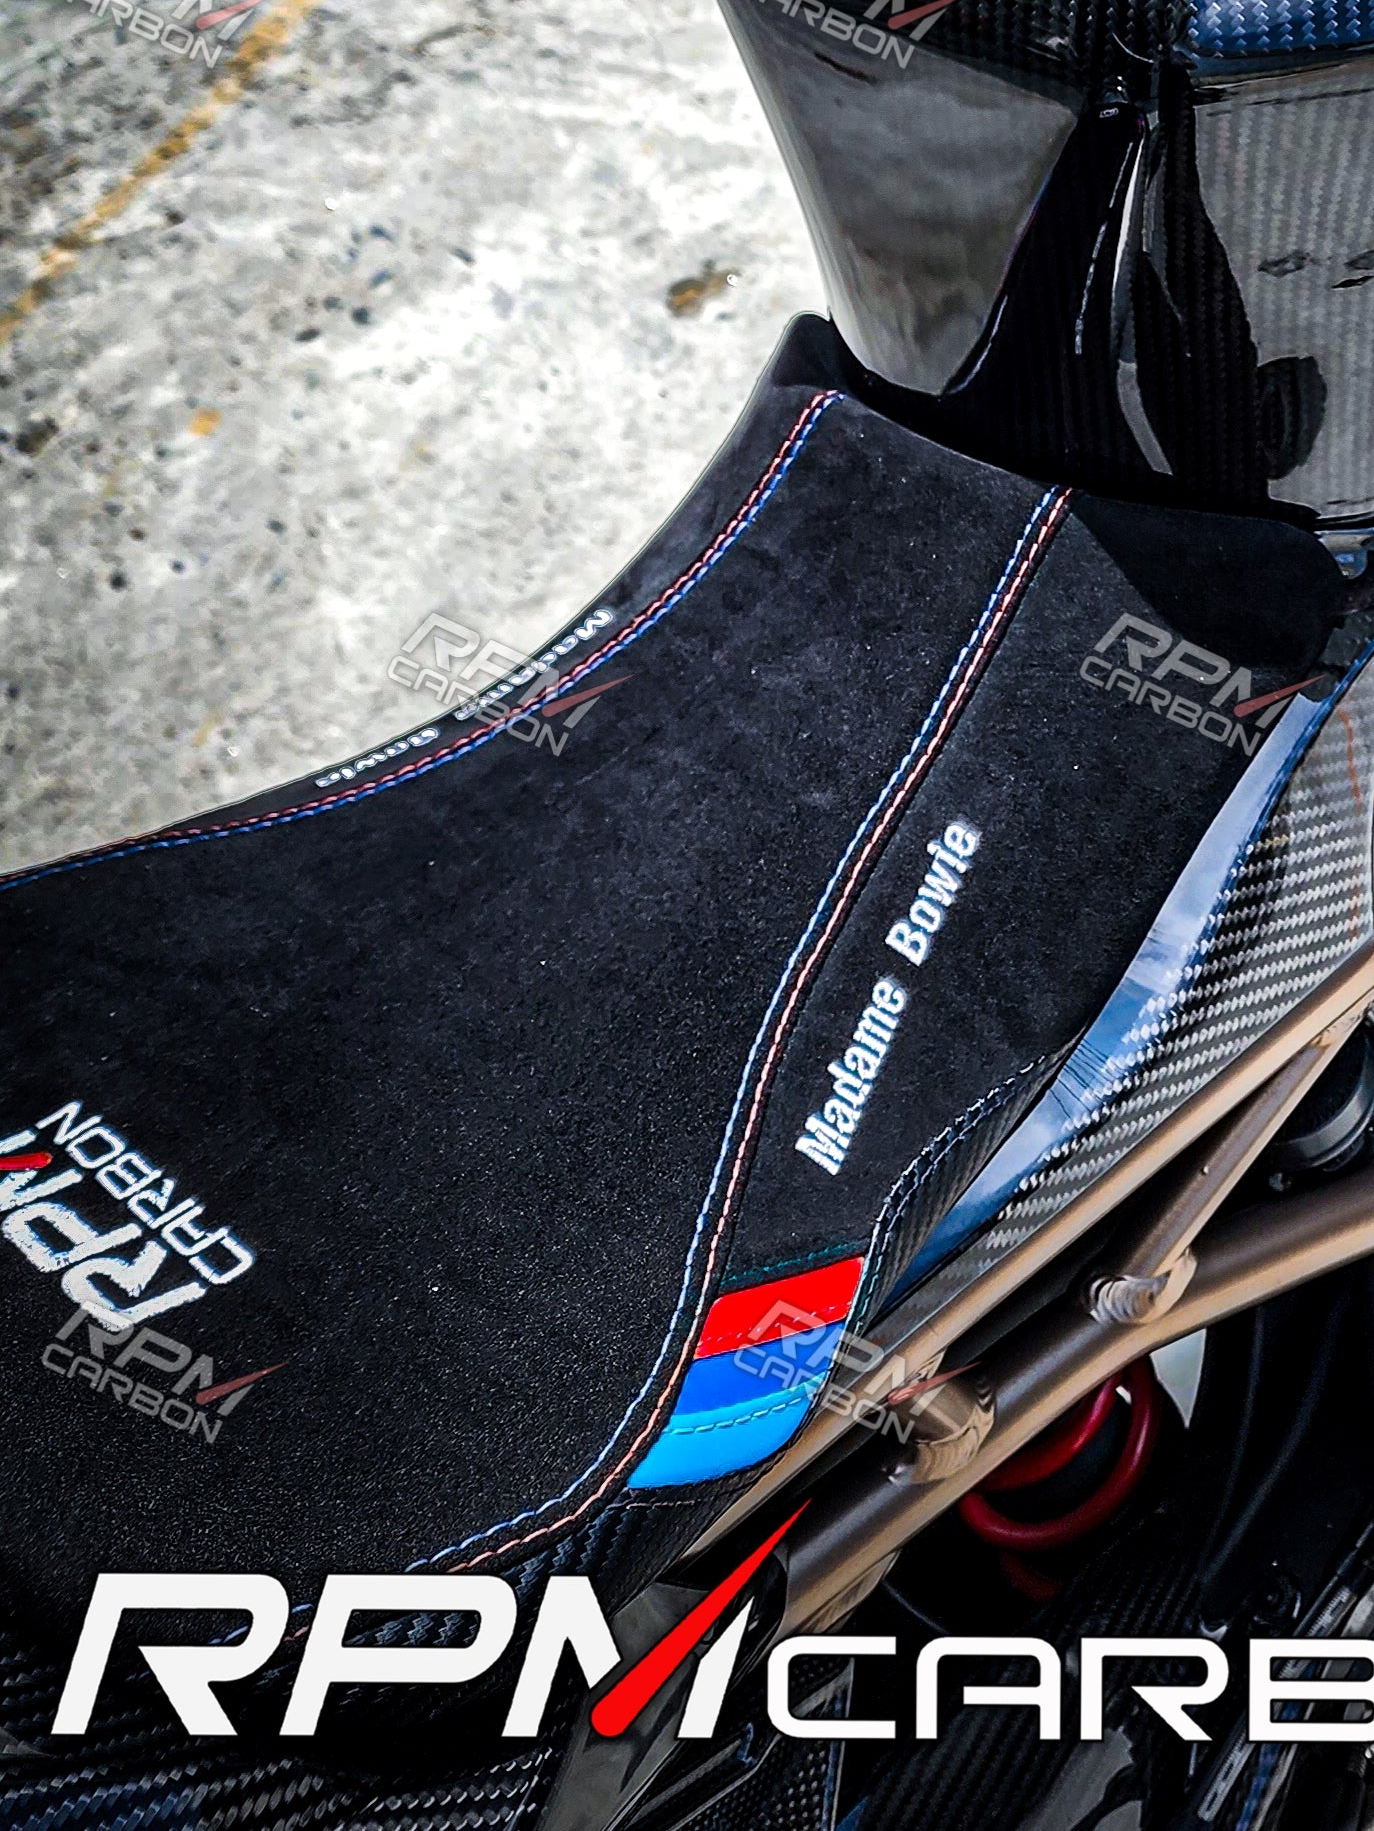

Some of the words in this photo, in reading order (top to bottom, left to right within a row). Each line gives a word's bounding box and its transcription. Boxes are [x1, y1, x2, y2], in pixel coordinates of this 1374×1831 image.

[794, 976, 907, 1176] Madame
[885, 821, 980, 967] Bowie
[36, 1100, 257, 1286] CARBON
